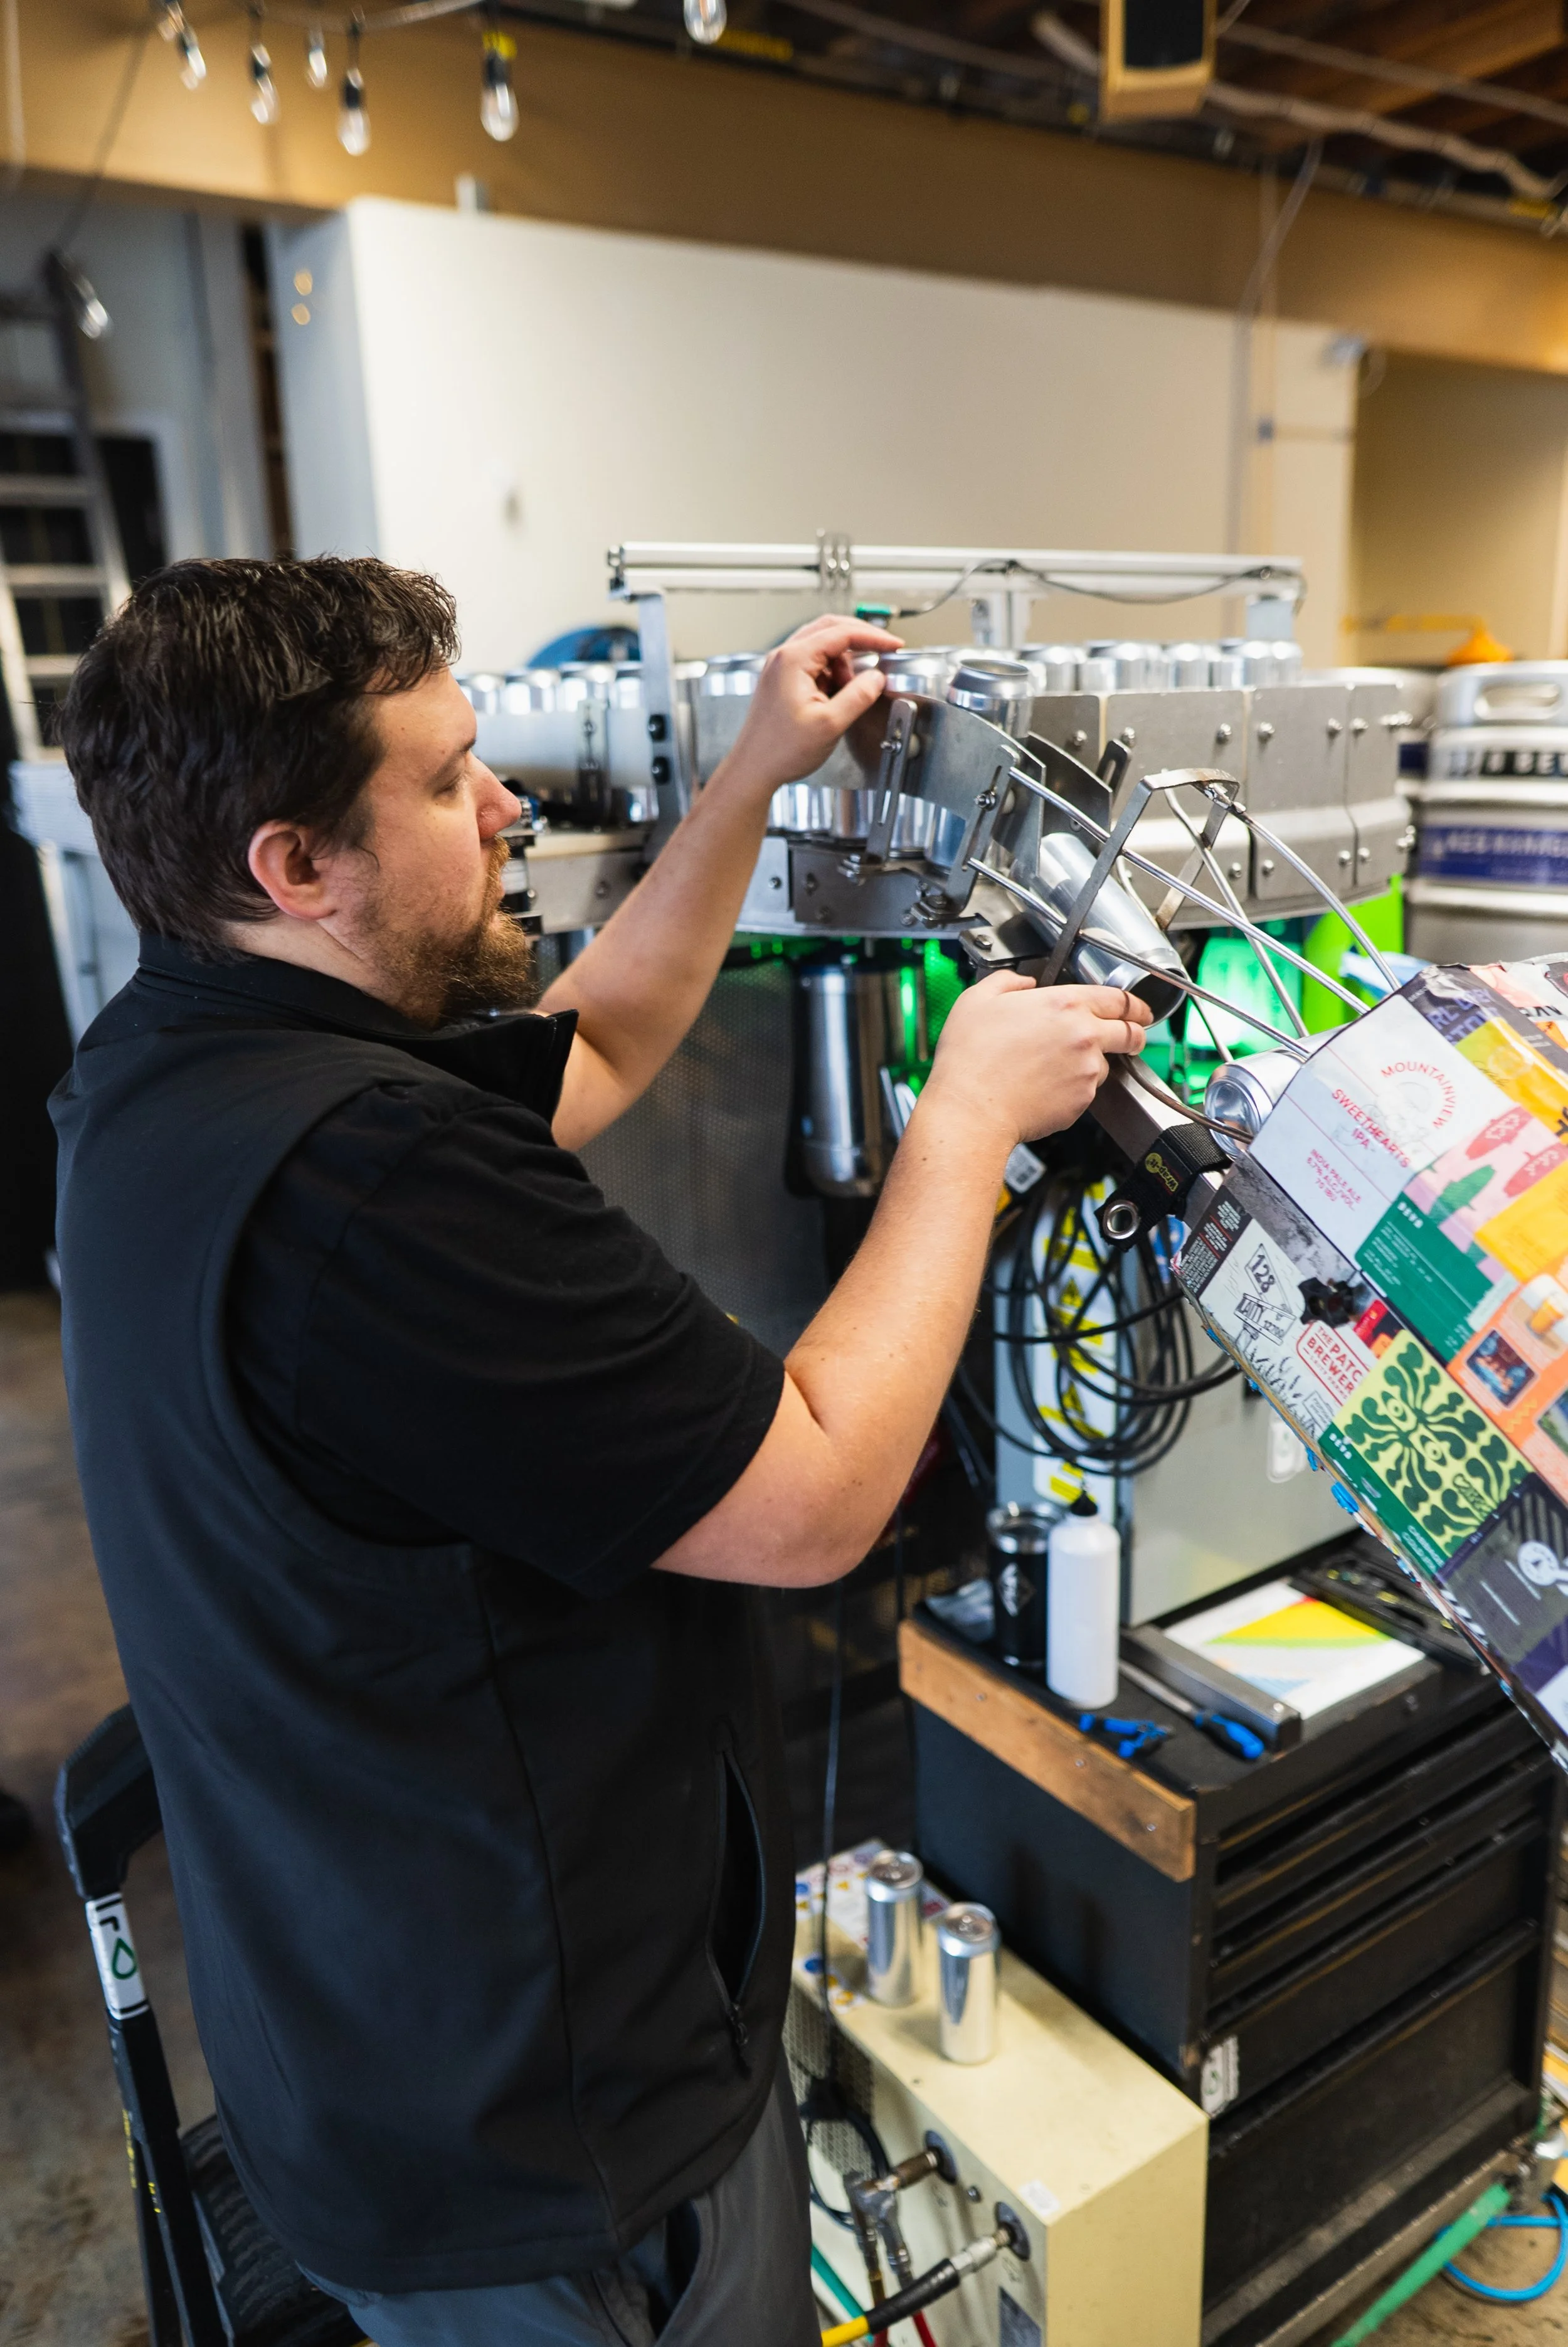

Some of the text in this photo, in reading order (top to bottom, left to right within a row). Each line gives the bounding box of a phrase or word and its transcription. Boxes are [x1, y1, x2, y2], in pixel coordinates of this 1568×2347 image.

[1332, 1089, 1411, 1168] SWEETHEARTS
[1352, 1128, 1370, 1150] IPA
[1330, 1168, 1347, 1189] PALE
[1347, 1188, 1362, 1204] ALE
[1252, 1254, 1275, 1293] 128
[1307, 1337, 1355, 1395] BREWER
[1318, 1325, 1333, 1345] THE
[1330, 1343, 1364, 1382] PATC
